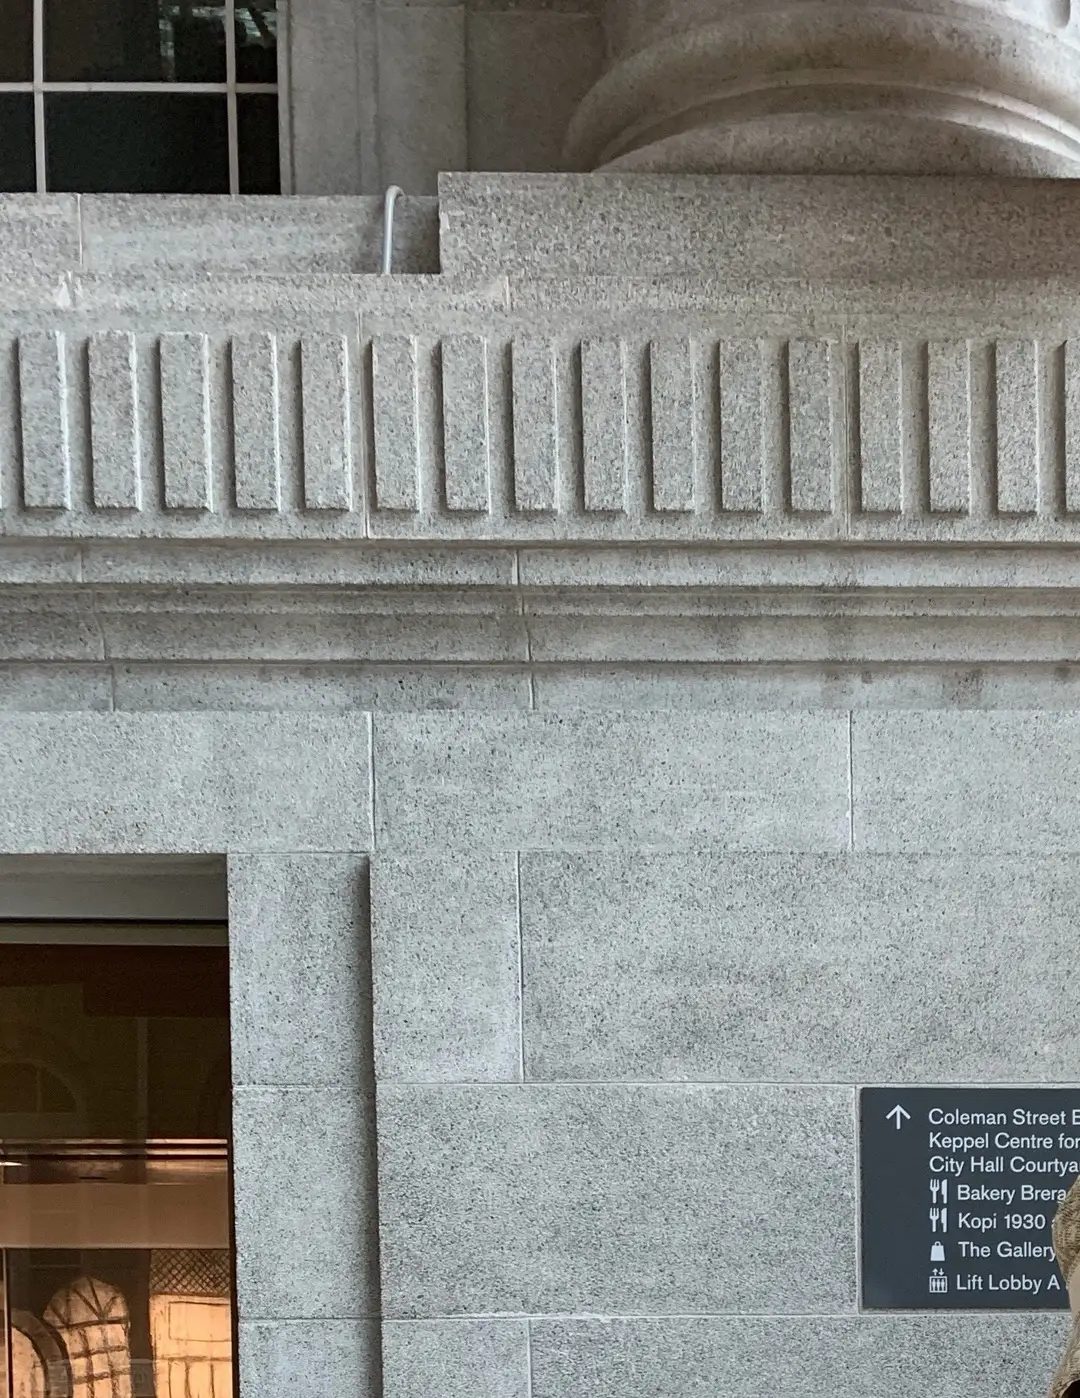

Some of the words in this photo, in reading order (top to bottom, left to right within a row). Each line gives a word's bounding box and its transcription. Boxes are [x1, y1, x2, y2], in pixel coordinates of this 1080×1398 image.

[928, 1107, 1007, 1126] Coleman
[1012, 1107, 1066, 1126] Street
[928, 1131, 989, 1152] Keppel
[994, 1131, 1053, 1149] Centre
[928, 1155, 965, 1177] City
[970, 1156, 1004, 1173] Hall
[956, 1184, 1016, 1205] Bakery
[1020, 1184, 1066, 1201] Brera
[957, 1212, 997, 1233] Kopi
[1003, 1213, 1046, 1230] 1930
[957, 1241, 991, 1258] The
[996, 1241, 1056, 1262] Gallery
[956, 1274, 984, 1290] Lift
[988, 1274, 1042, 1295] Lobby
[1046, 1274, 1061, 1290] A
